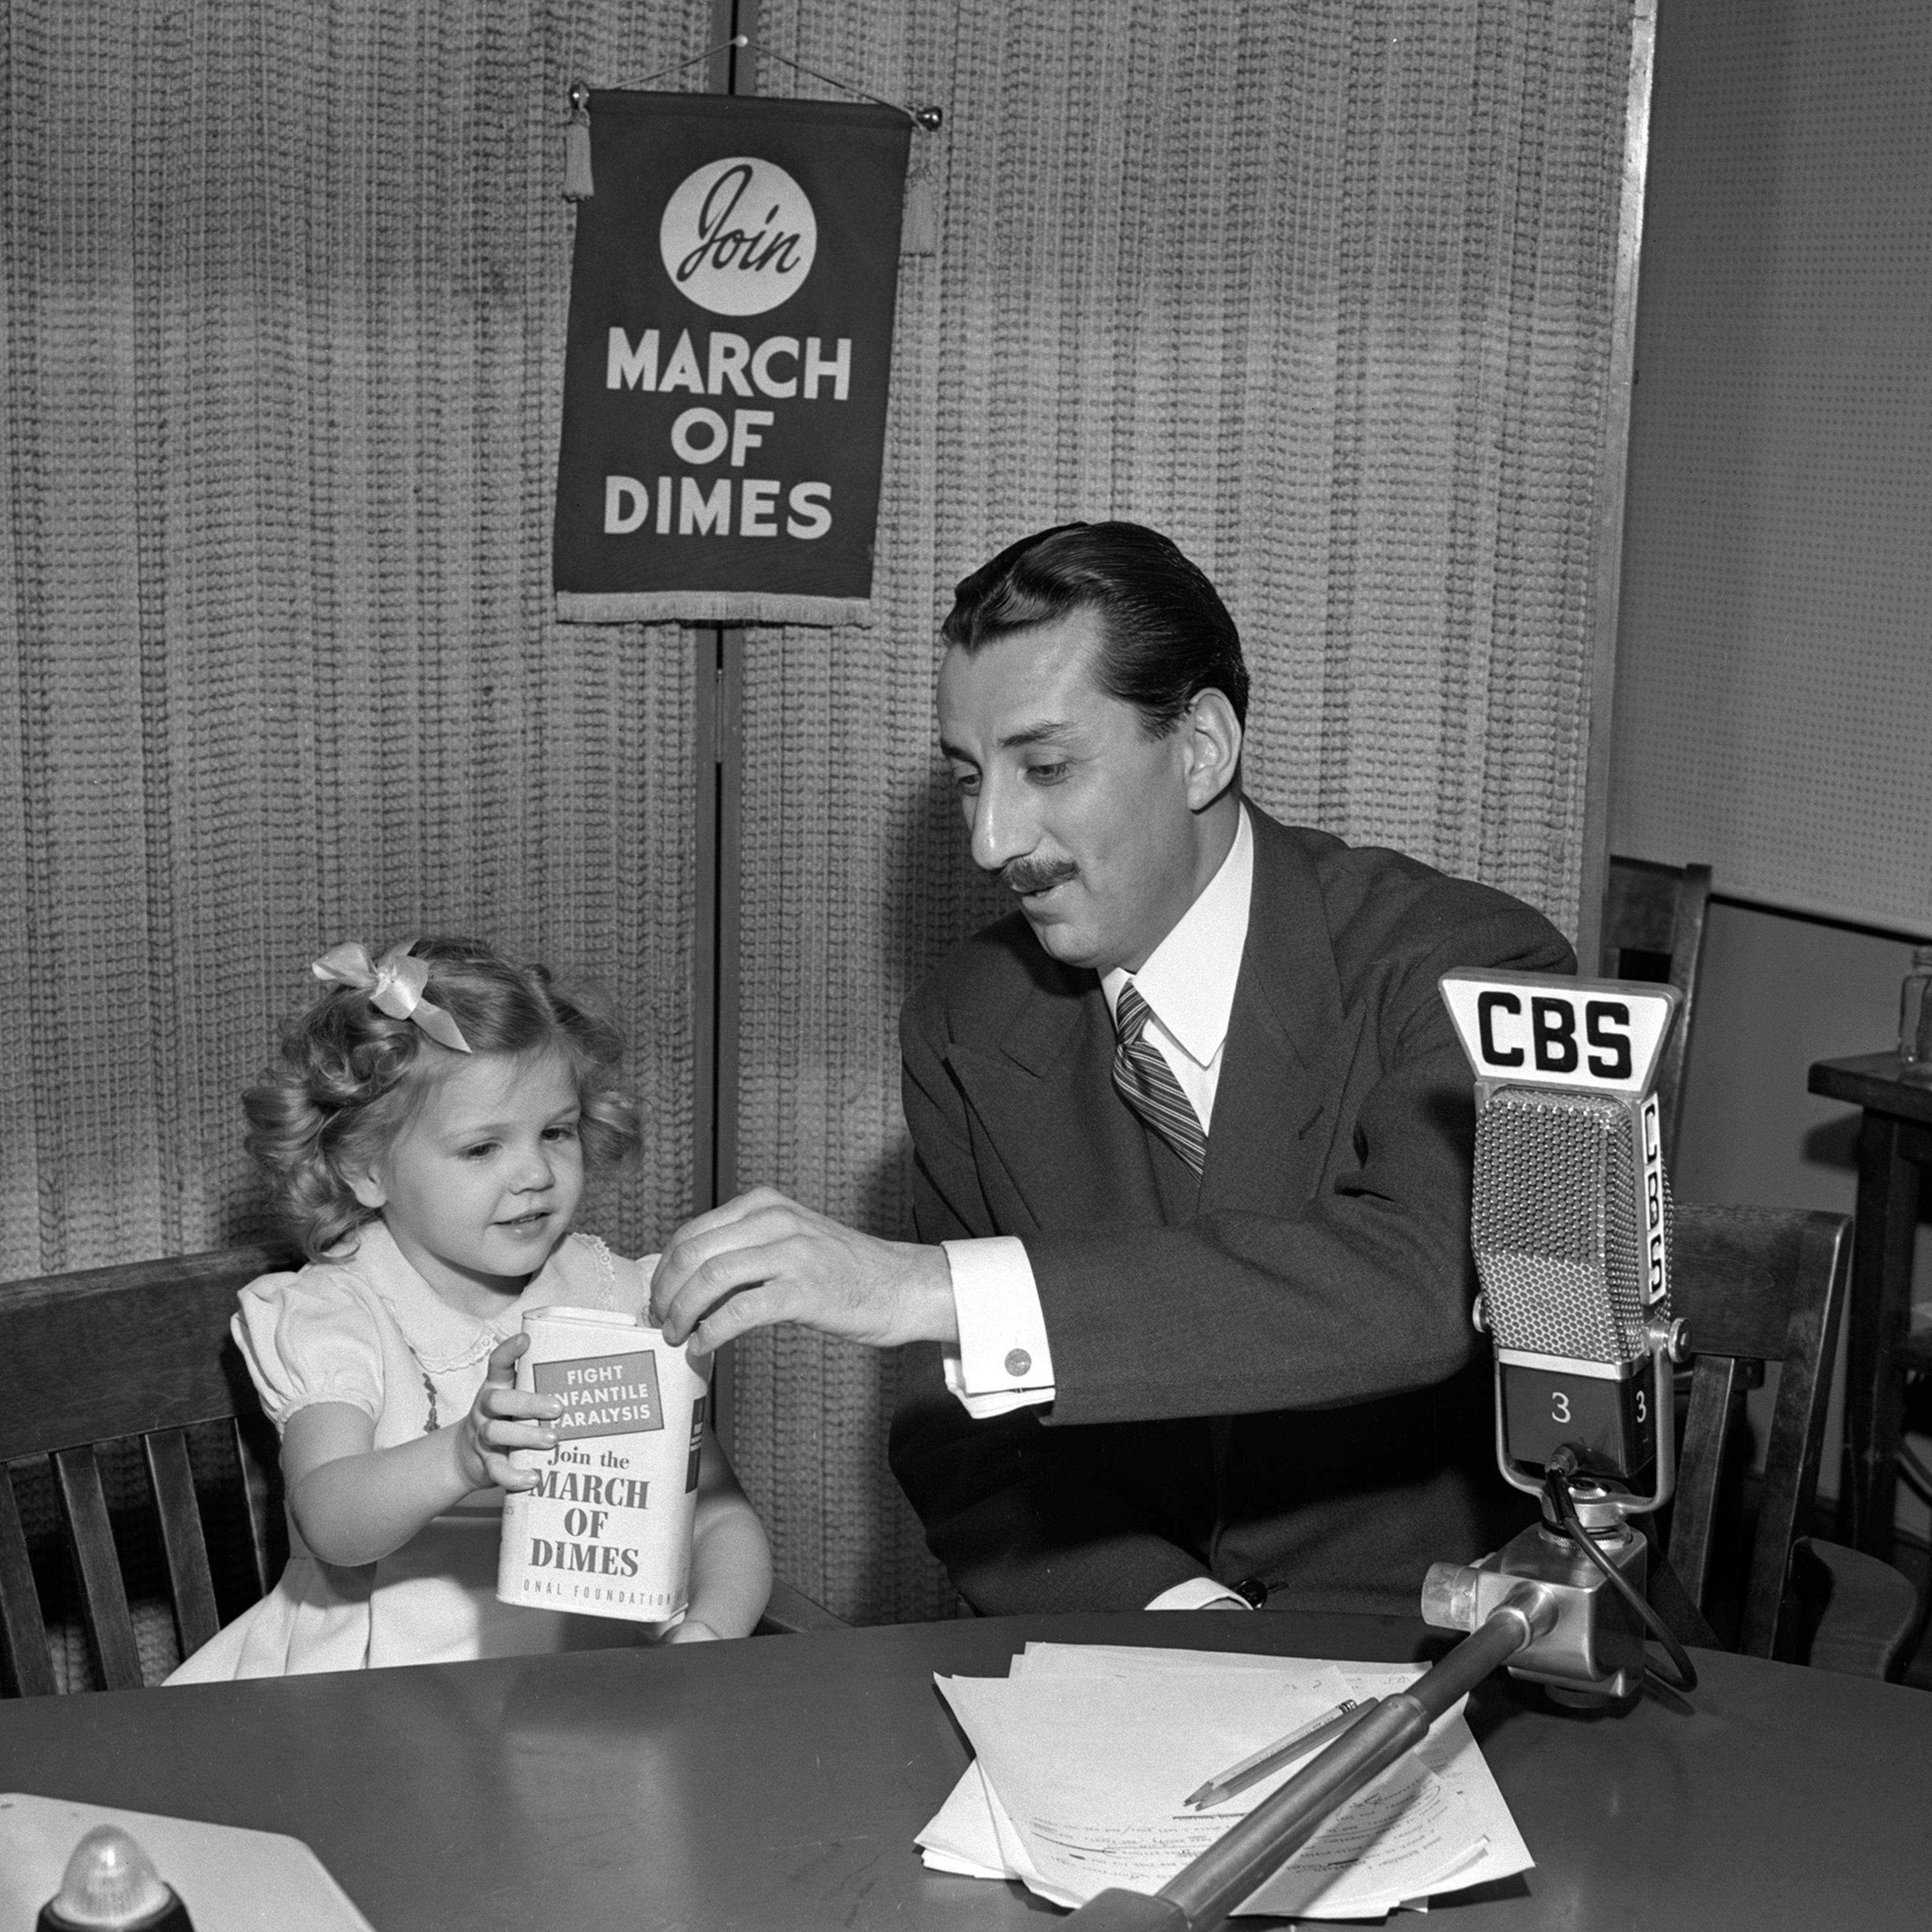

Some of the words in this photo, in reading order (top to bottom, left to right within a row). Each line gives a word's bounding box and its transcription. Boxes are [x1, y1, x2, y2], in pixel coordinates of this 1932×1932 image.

[676, 164, 801, 283] Join
[606, 327, 852, 400] MARCH
[670, 407, 775, 467] OF
[604, 475, 833, 540] DIMES
[1477, 991, 1634, 1080] CBS
[1644, 1103, 1663, 1294] CBS
[548, 1383, 649, 1407] NFANTILE
[567, 1364, 623, 1386] FIGHT
[1551, 1391, 1571, 1424] 3
[1636, 1390, 1647, 1424] 3
[547, 1444, 591, 1466] Join
[600, 1450, 630, 1470] the
[528, 1467, 651, 1510] MARCH
[564, 1507, 610, 1540] OF
[528, 1538, 639, 1578] DIMES
[574, 1585, 671, 1607] FOUNDATION
